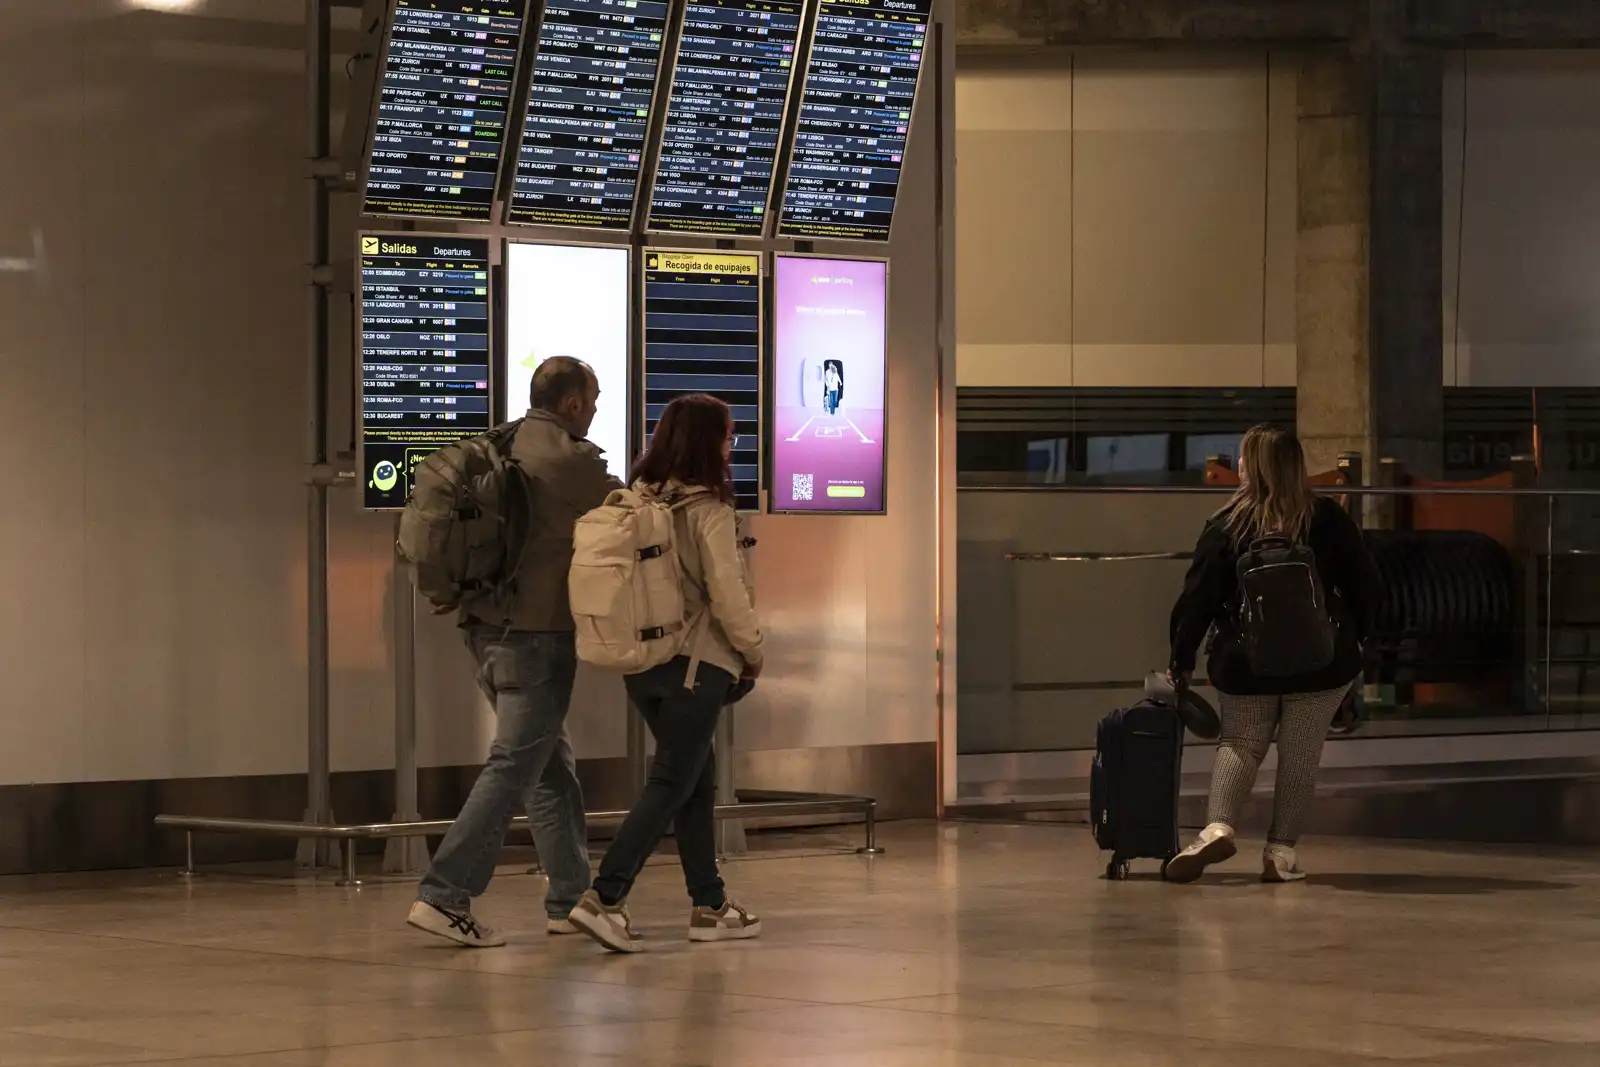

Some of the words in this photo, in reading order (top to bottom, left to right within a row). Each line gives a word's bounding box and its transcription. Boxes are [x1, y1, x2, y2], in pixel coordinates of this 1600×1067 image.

[884, 0, 916, 10] Departures
[382, 243, 417, 254] Salidas
[434, 247, 471, 256] Departures
[666, 261, 701, 270] Recogida
[715, 263, 750, 273] equipajes
